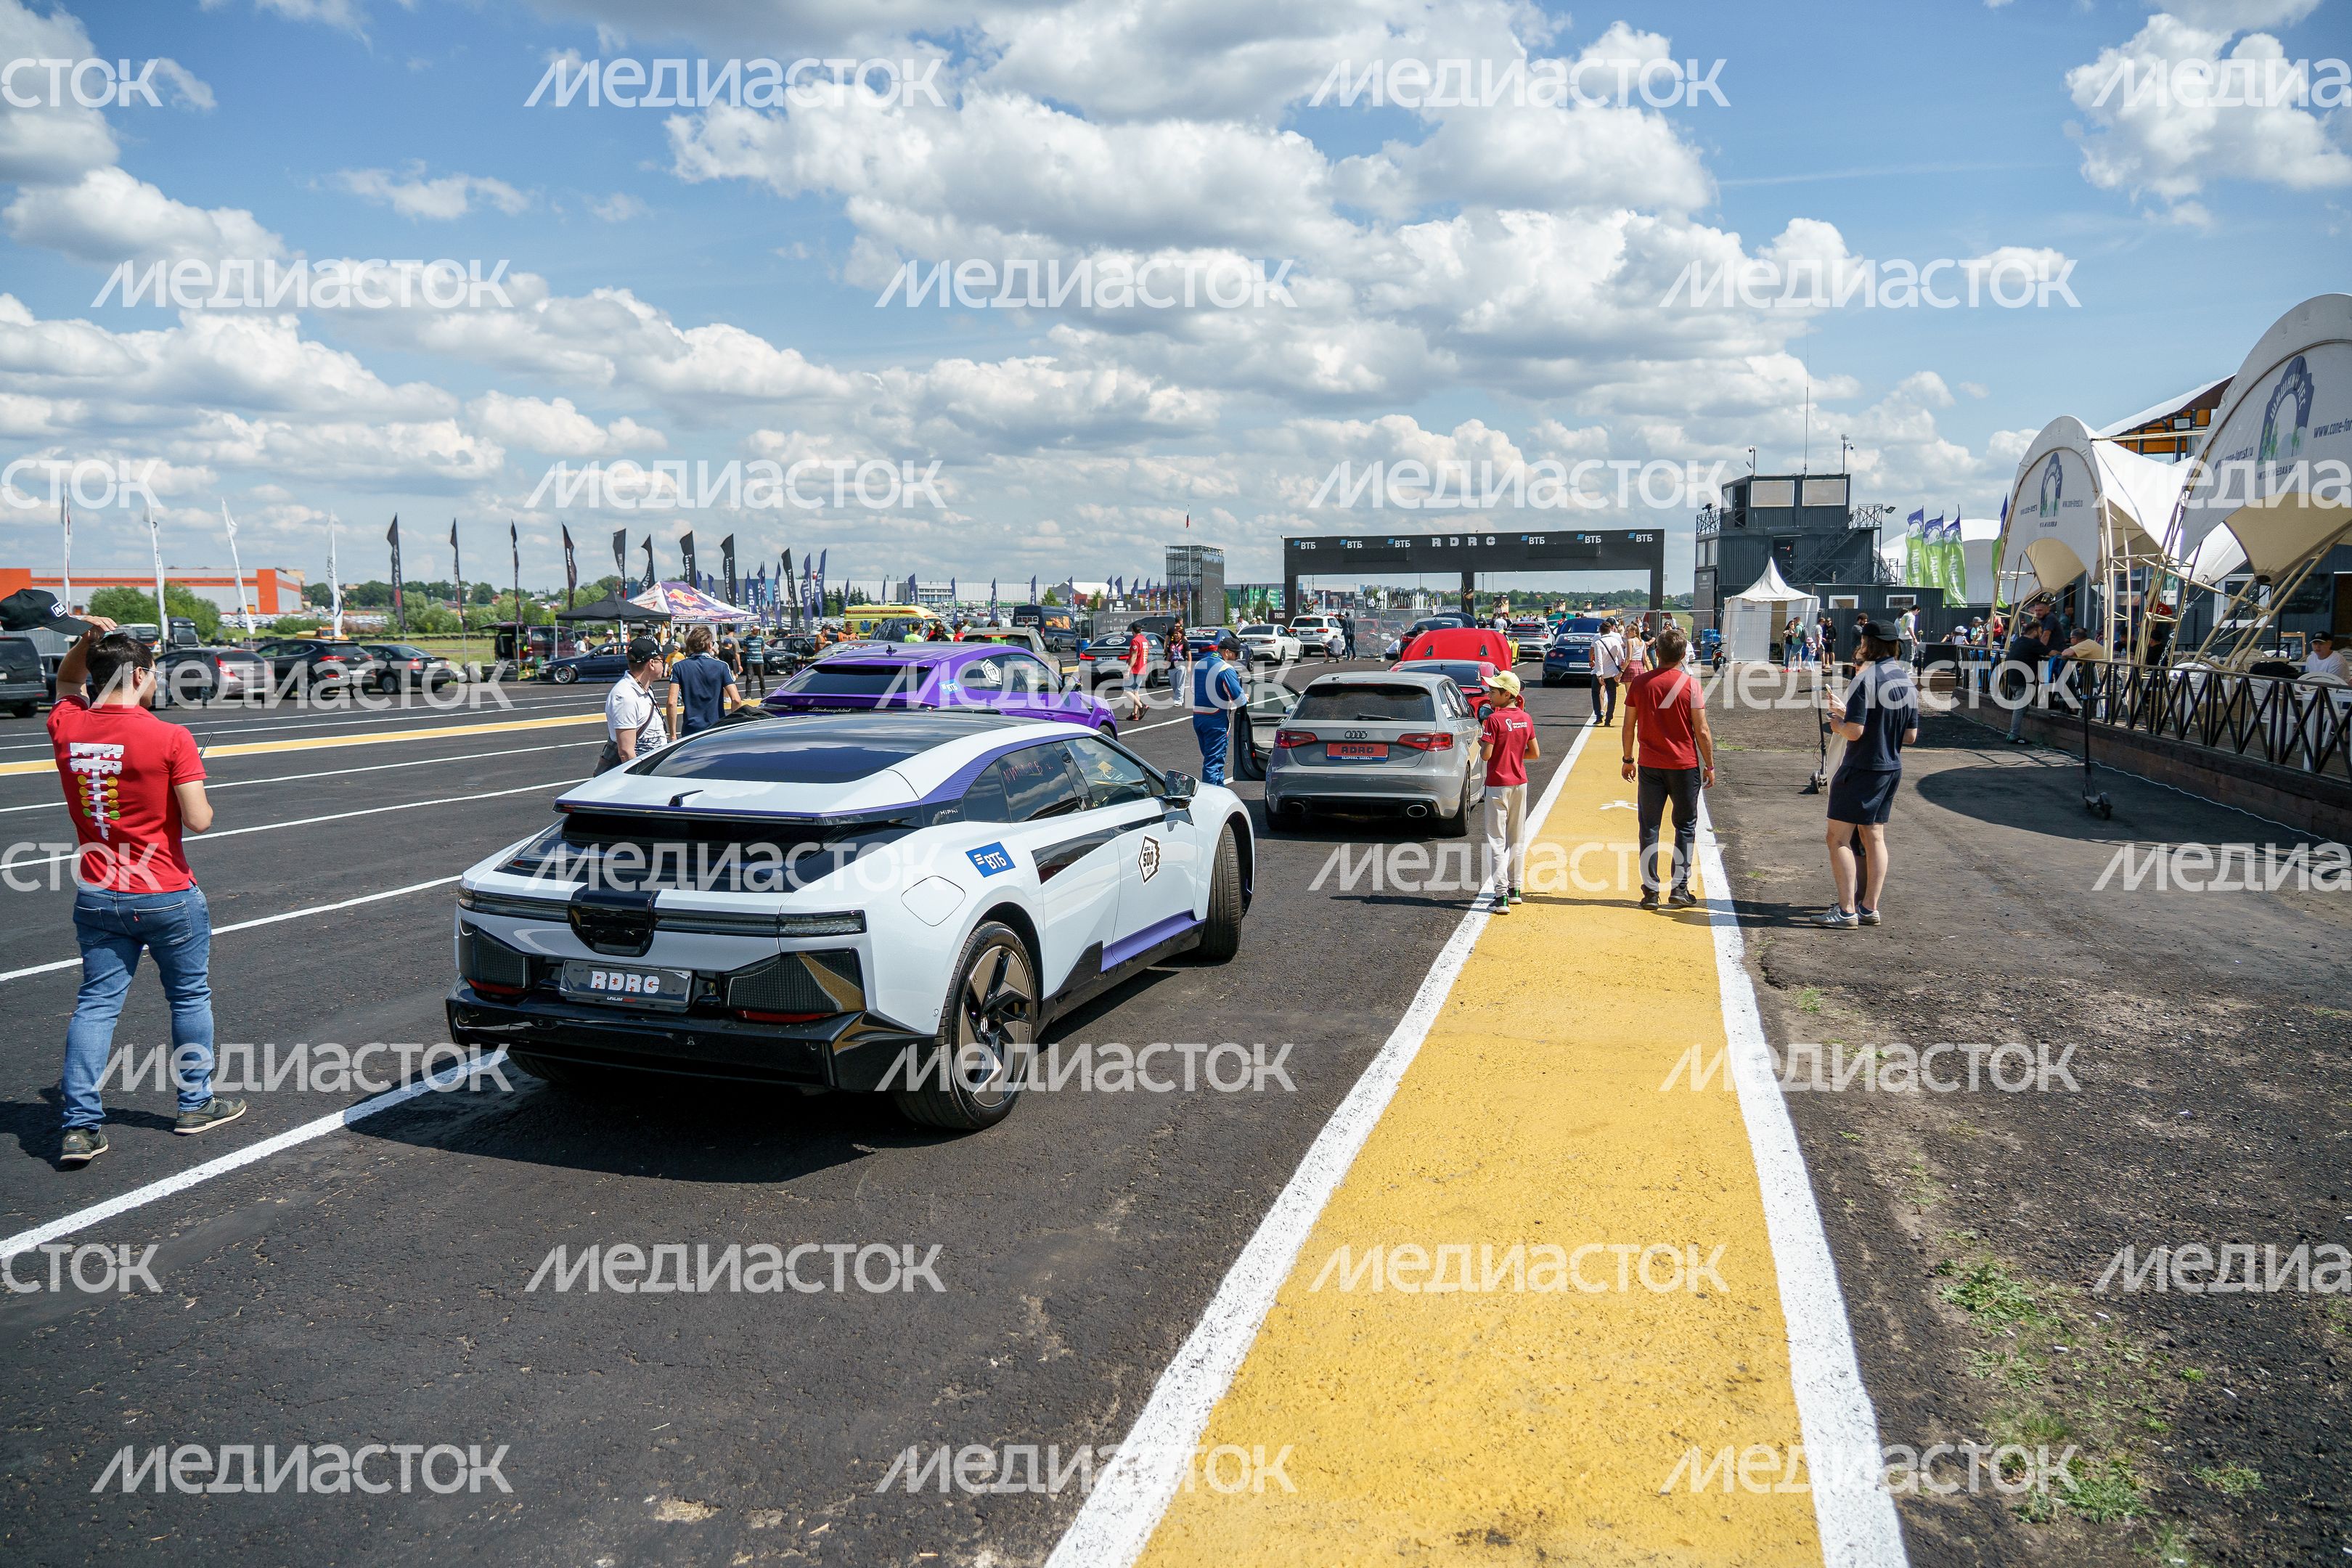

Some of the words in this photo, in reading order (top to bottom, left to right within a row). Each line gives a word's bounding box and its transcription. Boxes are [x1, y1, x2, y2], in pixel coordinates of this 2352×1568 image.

[2298, 380, 2306, 410] ЛЕС
[1395, 539, 1410, 548] ВТБ
[1529, 536, 1545, 544] ВТБ
[1585, 535, 1601, 544] ВТБ
[1636, 534, 1653, 543] ВТБ
[946, 682, 958, 692] ВТБ
[984, 852, 1007, 870] ВТБ
[1143, 851, 1153, 867] 500
[591, 971, 660, 994] RDRC
